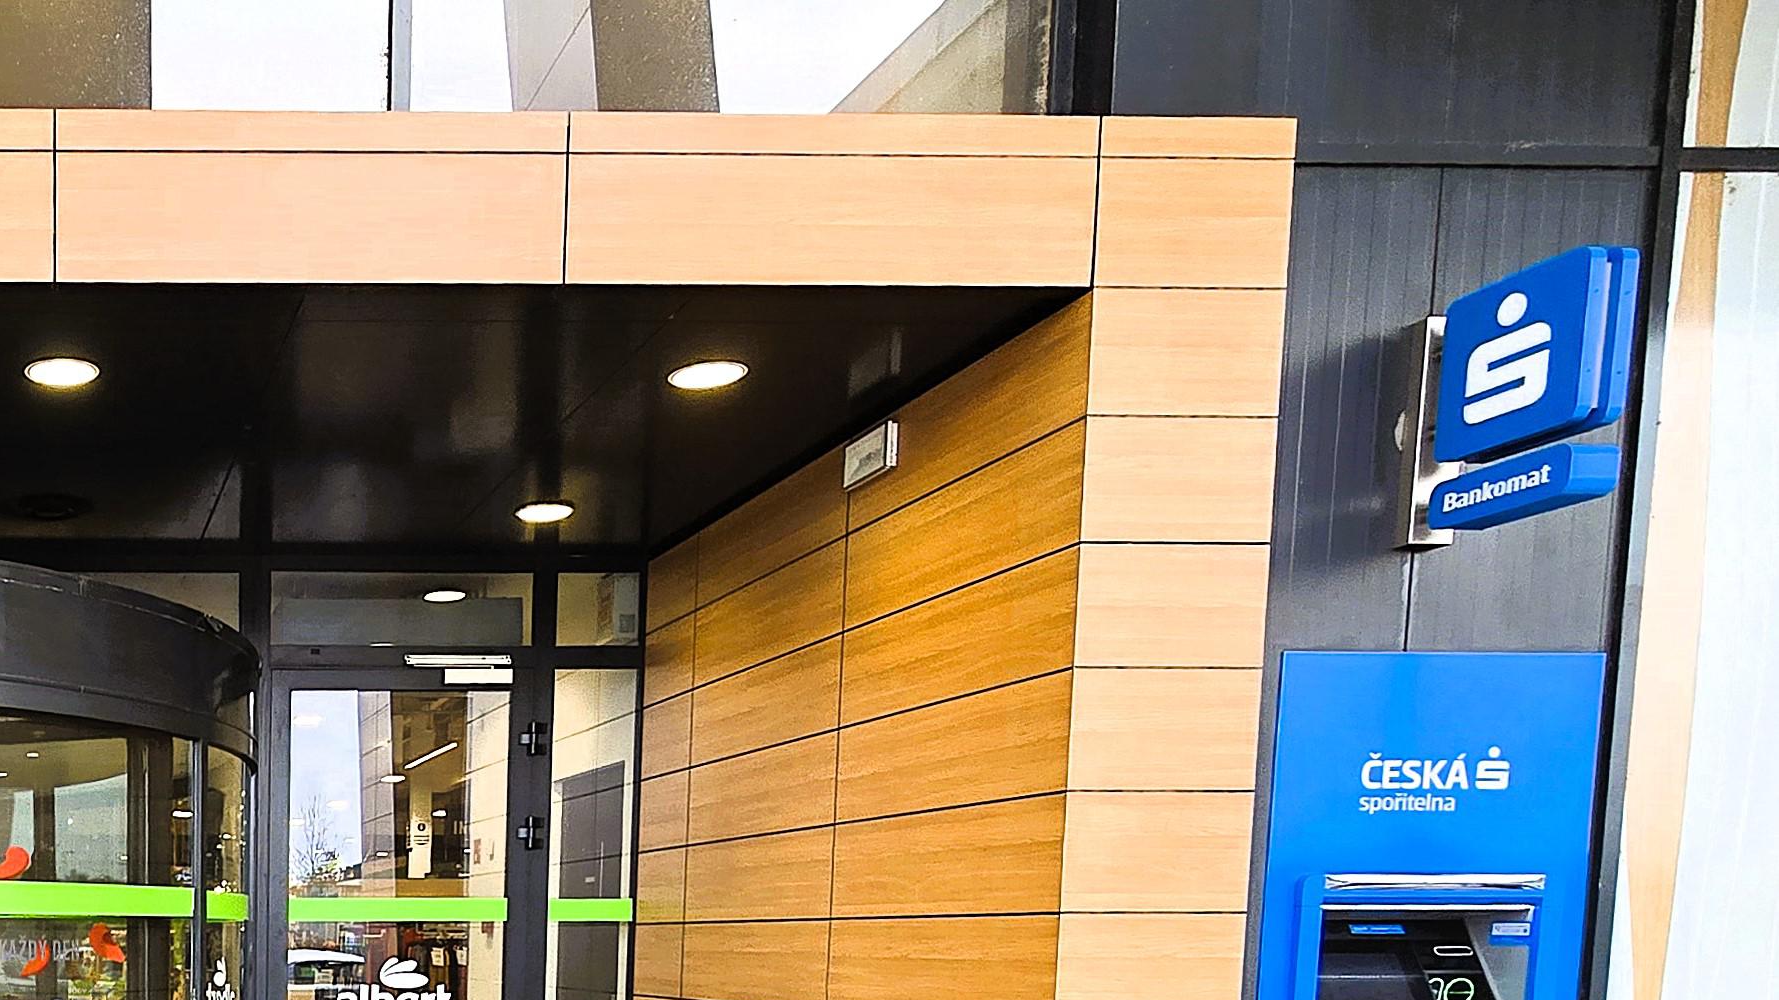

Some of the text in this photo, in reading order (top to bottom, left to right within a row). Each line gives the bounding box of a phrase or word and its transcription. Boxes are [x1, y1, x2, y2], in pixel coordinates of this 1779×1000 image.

[1441, 464, 1552, 513] Bankomat
[1360, 752, 1470, 790] ČESKÁ
[1358, 792, 1457, 815] spořitelna
[52, 938, 81, 962] DEN
